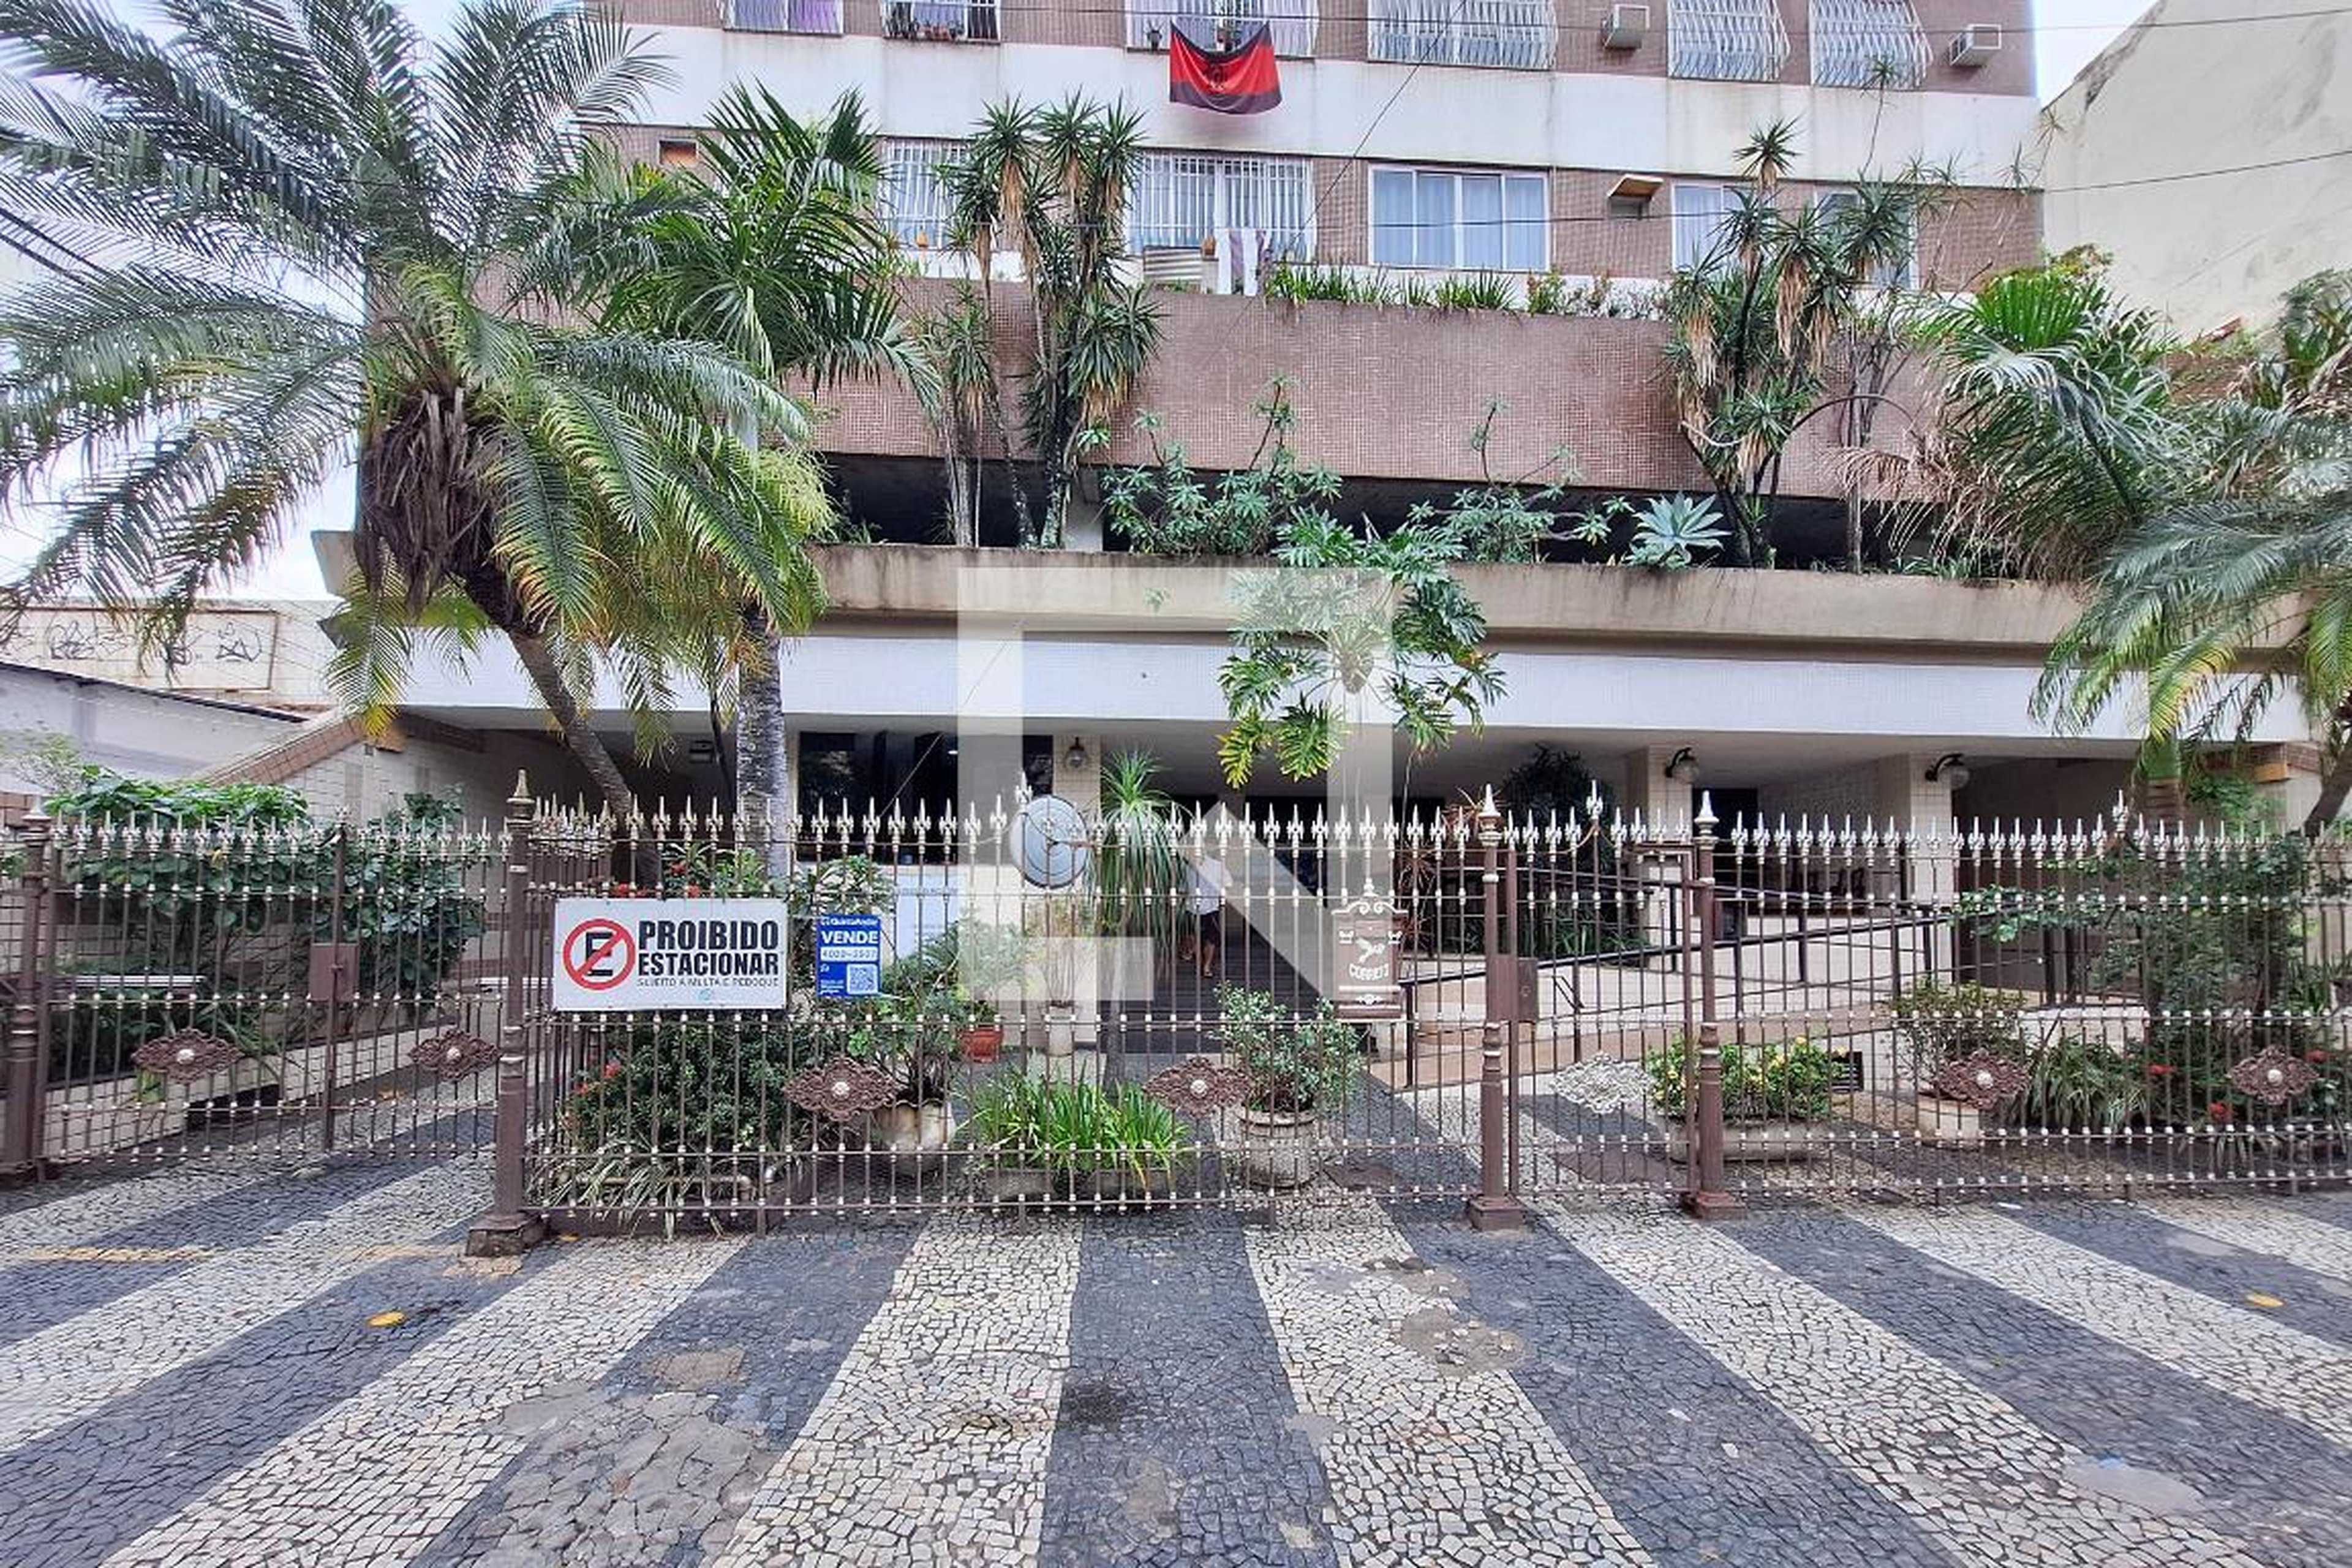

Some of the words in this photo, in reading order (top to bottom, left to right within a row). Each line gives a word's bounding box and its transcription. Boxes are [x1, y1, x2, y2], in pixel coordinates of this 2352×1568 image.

[639, 920, 778, 950] PROIBIDO
[821, 930, 878, 944] VENDE
[638, 952, 778, 976] ESTACIONAR
